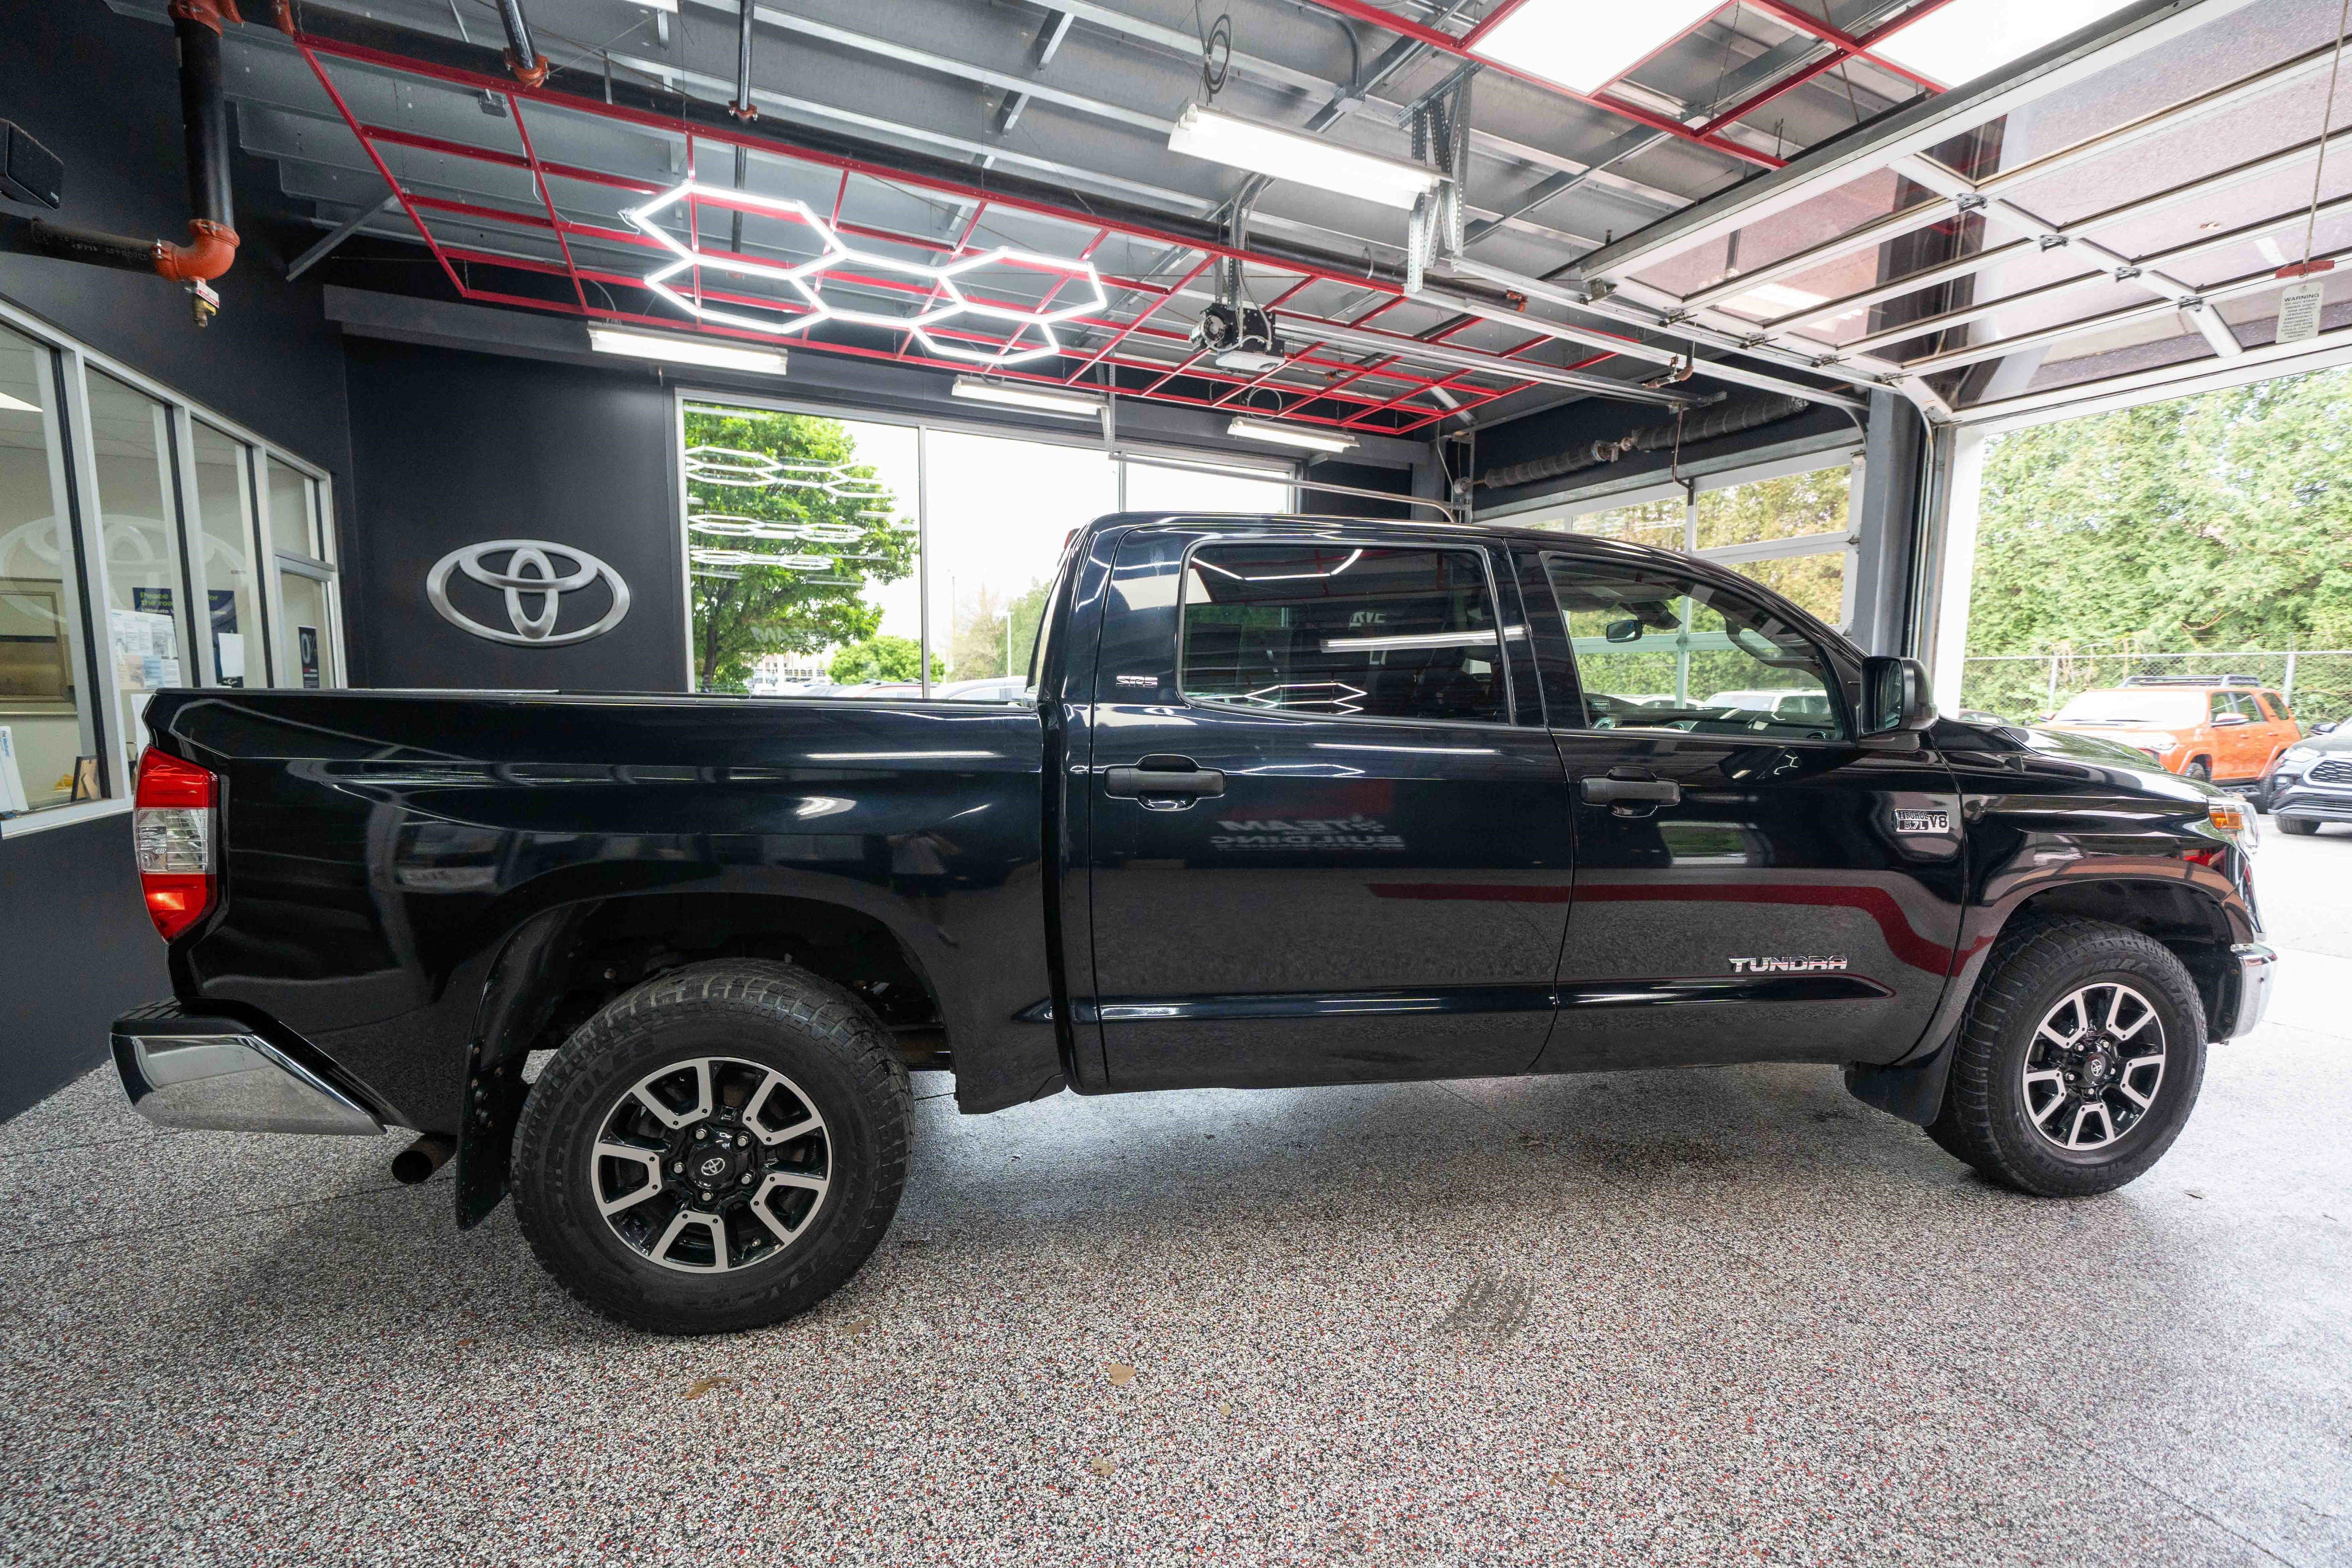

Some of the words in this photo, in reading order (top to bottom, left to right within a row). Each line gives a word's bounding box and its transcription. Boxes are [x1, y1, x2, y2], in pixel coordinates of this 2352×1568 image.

[2285, 293, 2319, 301] WARNING
[140, 591, 168, 599] Peace
[1116, 675, 1158, 688] SR5
[1928, 815, 1948, 828] V8
[1728, 955, 1847, 973] TUNDRA
